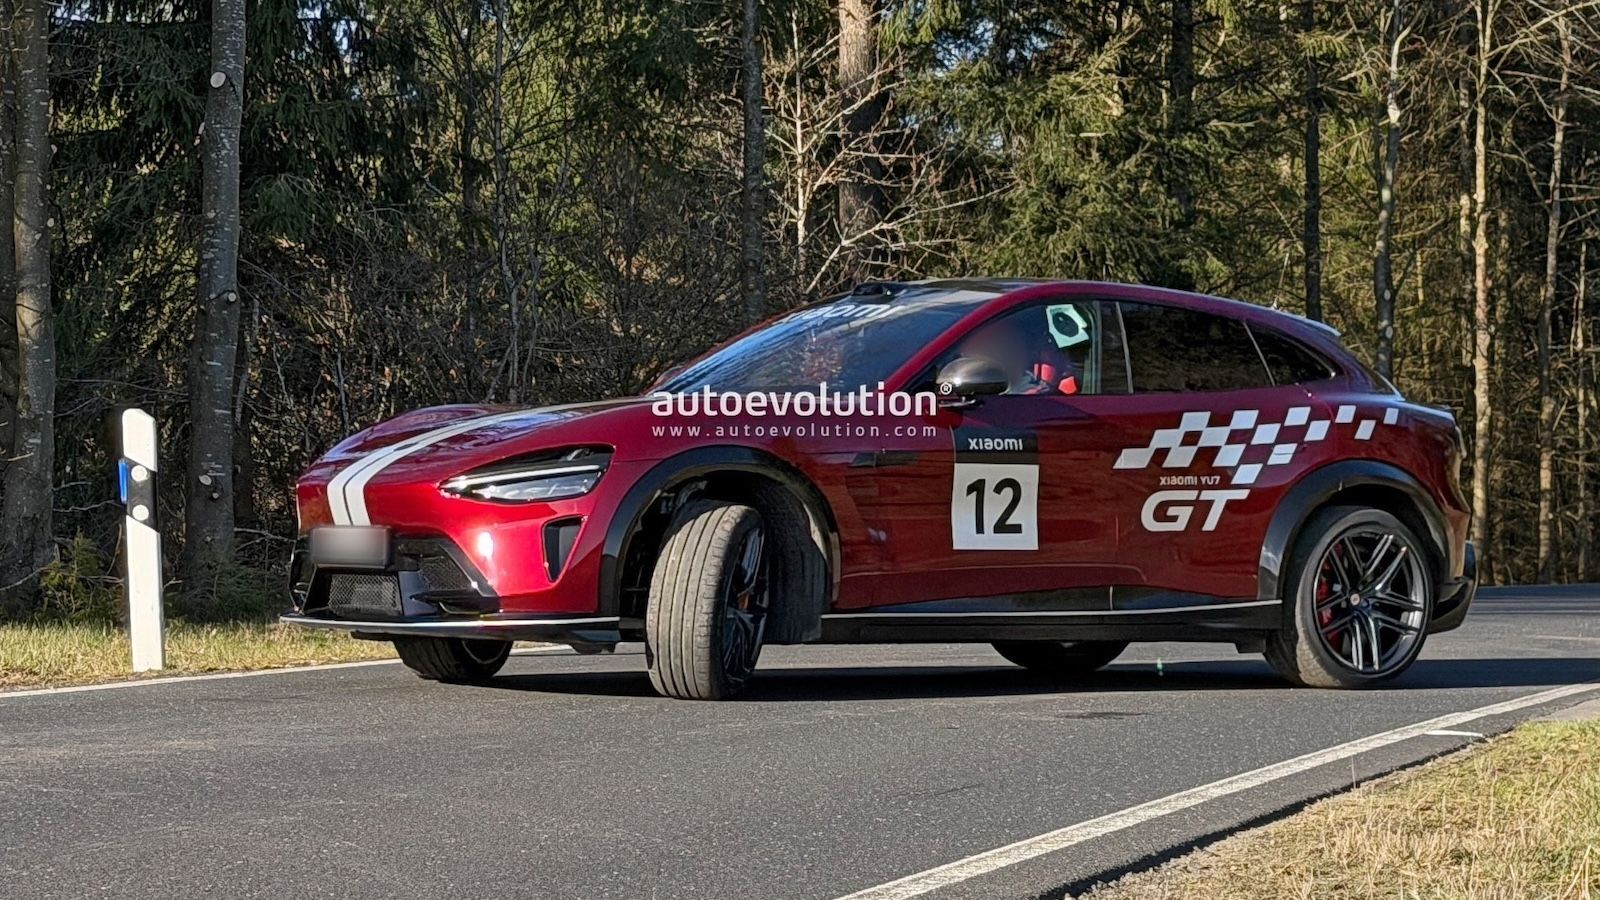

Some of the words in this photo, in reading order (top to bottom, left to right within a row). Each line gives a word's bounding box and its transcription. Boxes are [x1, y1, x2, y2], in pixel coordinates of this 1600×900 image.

[1200, 475, 1221, 486] YU7
[966, 478, 1023, 535] 12
[1140, 489, 1250, 532] GT
